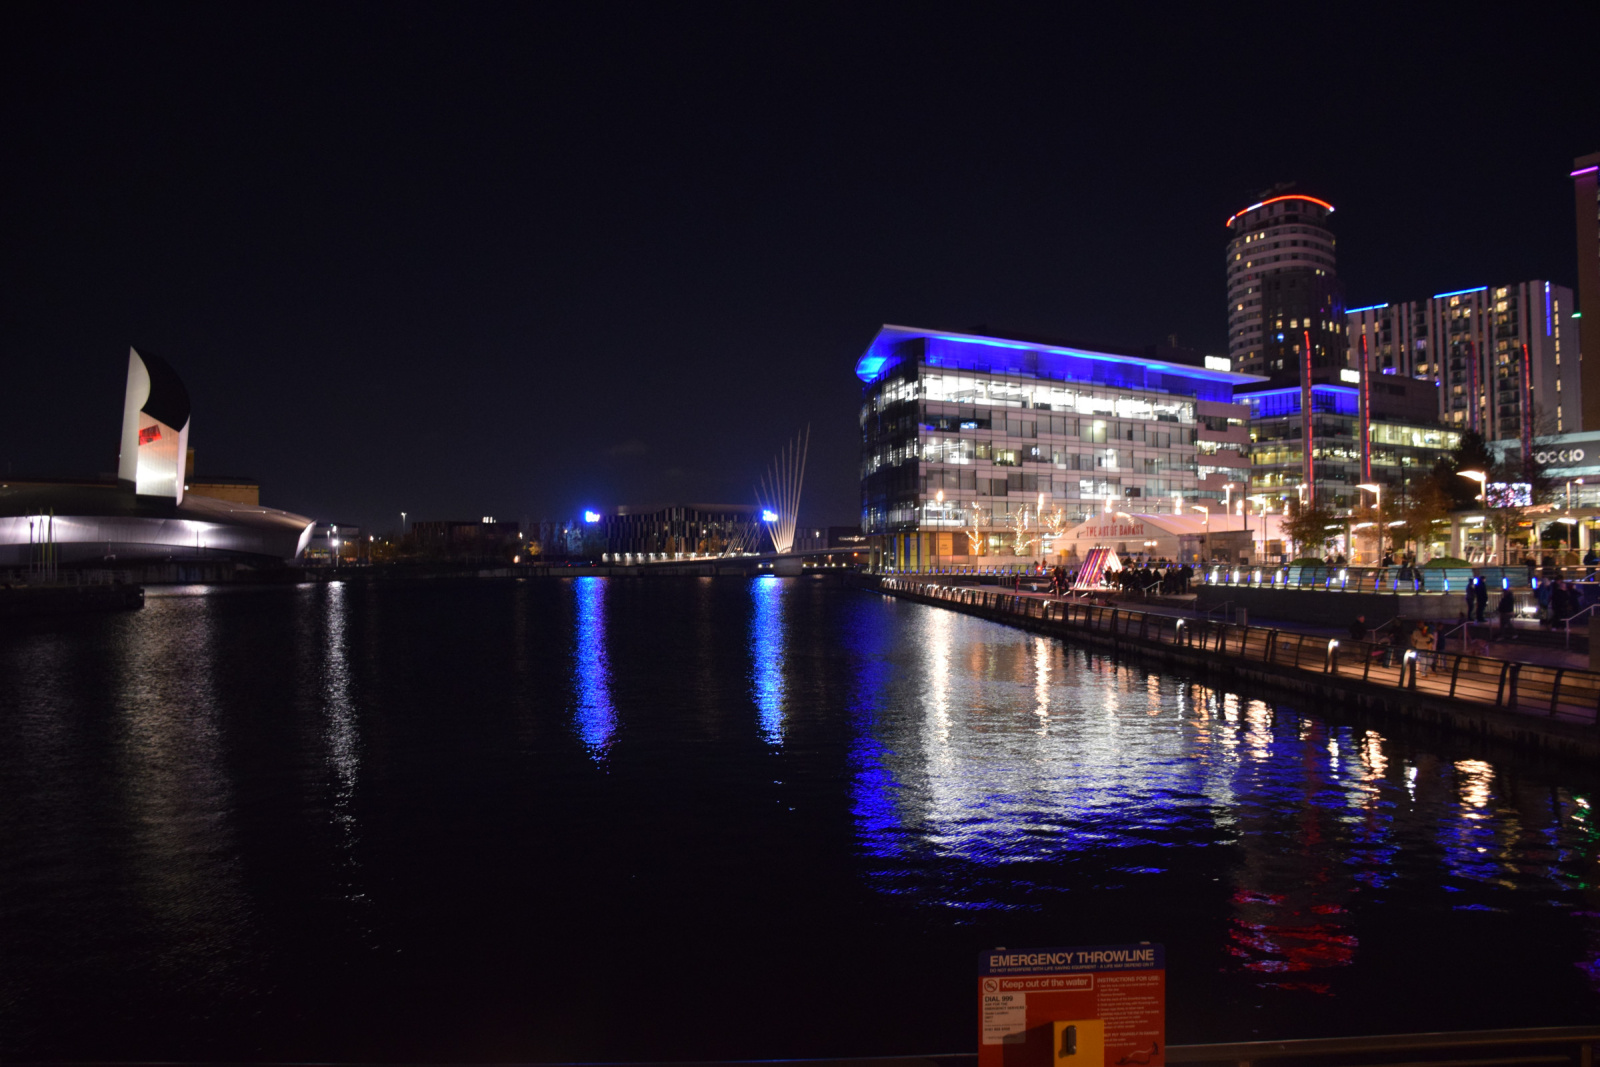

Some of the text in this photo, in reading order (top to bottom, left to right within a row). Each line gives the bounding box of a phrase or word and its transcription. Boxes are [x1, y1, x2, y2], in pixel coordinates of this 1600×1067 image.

[1086, 526, 1097, 537] THE
[1098, 525, 1109, 537] ART
[1110, 525, 1118, 537] OF
[990, 949, 1155, 967] EMERGENCY THROWLINE
[1002, 980, 1024, 990] Keep
[1026, 980, 1039, 988] out
[1041, 979, 1050, 987] of
[1050, 978, 1064, 987] the
[1066, 978, 1088, 987] water
